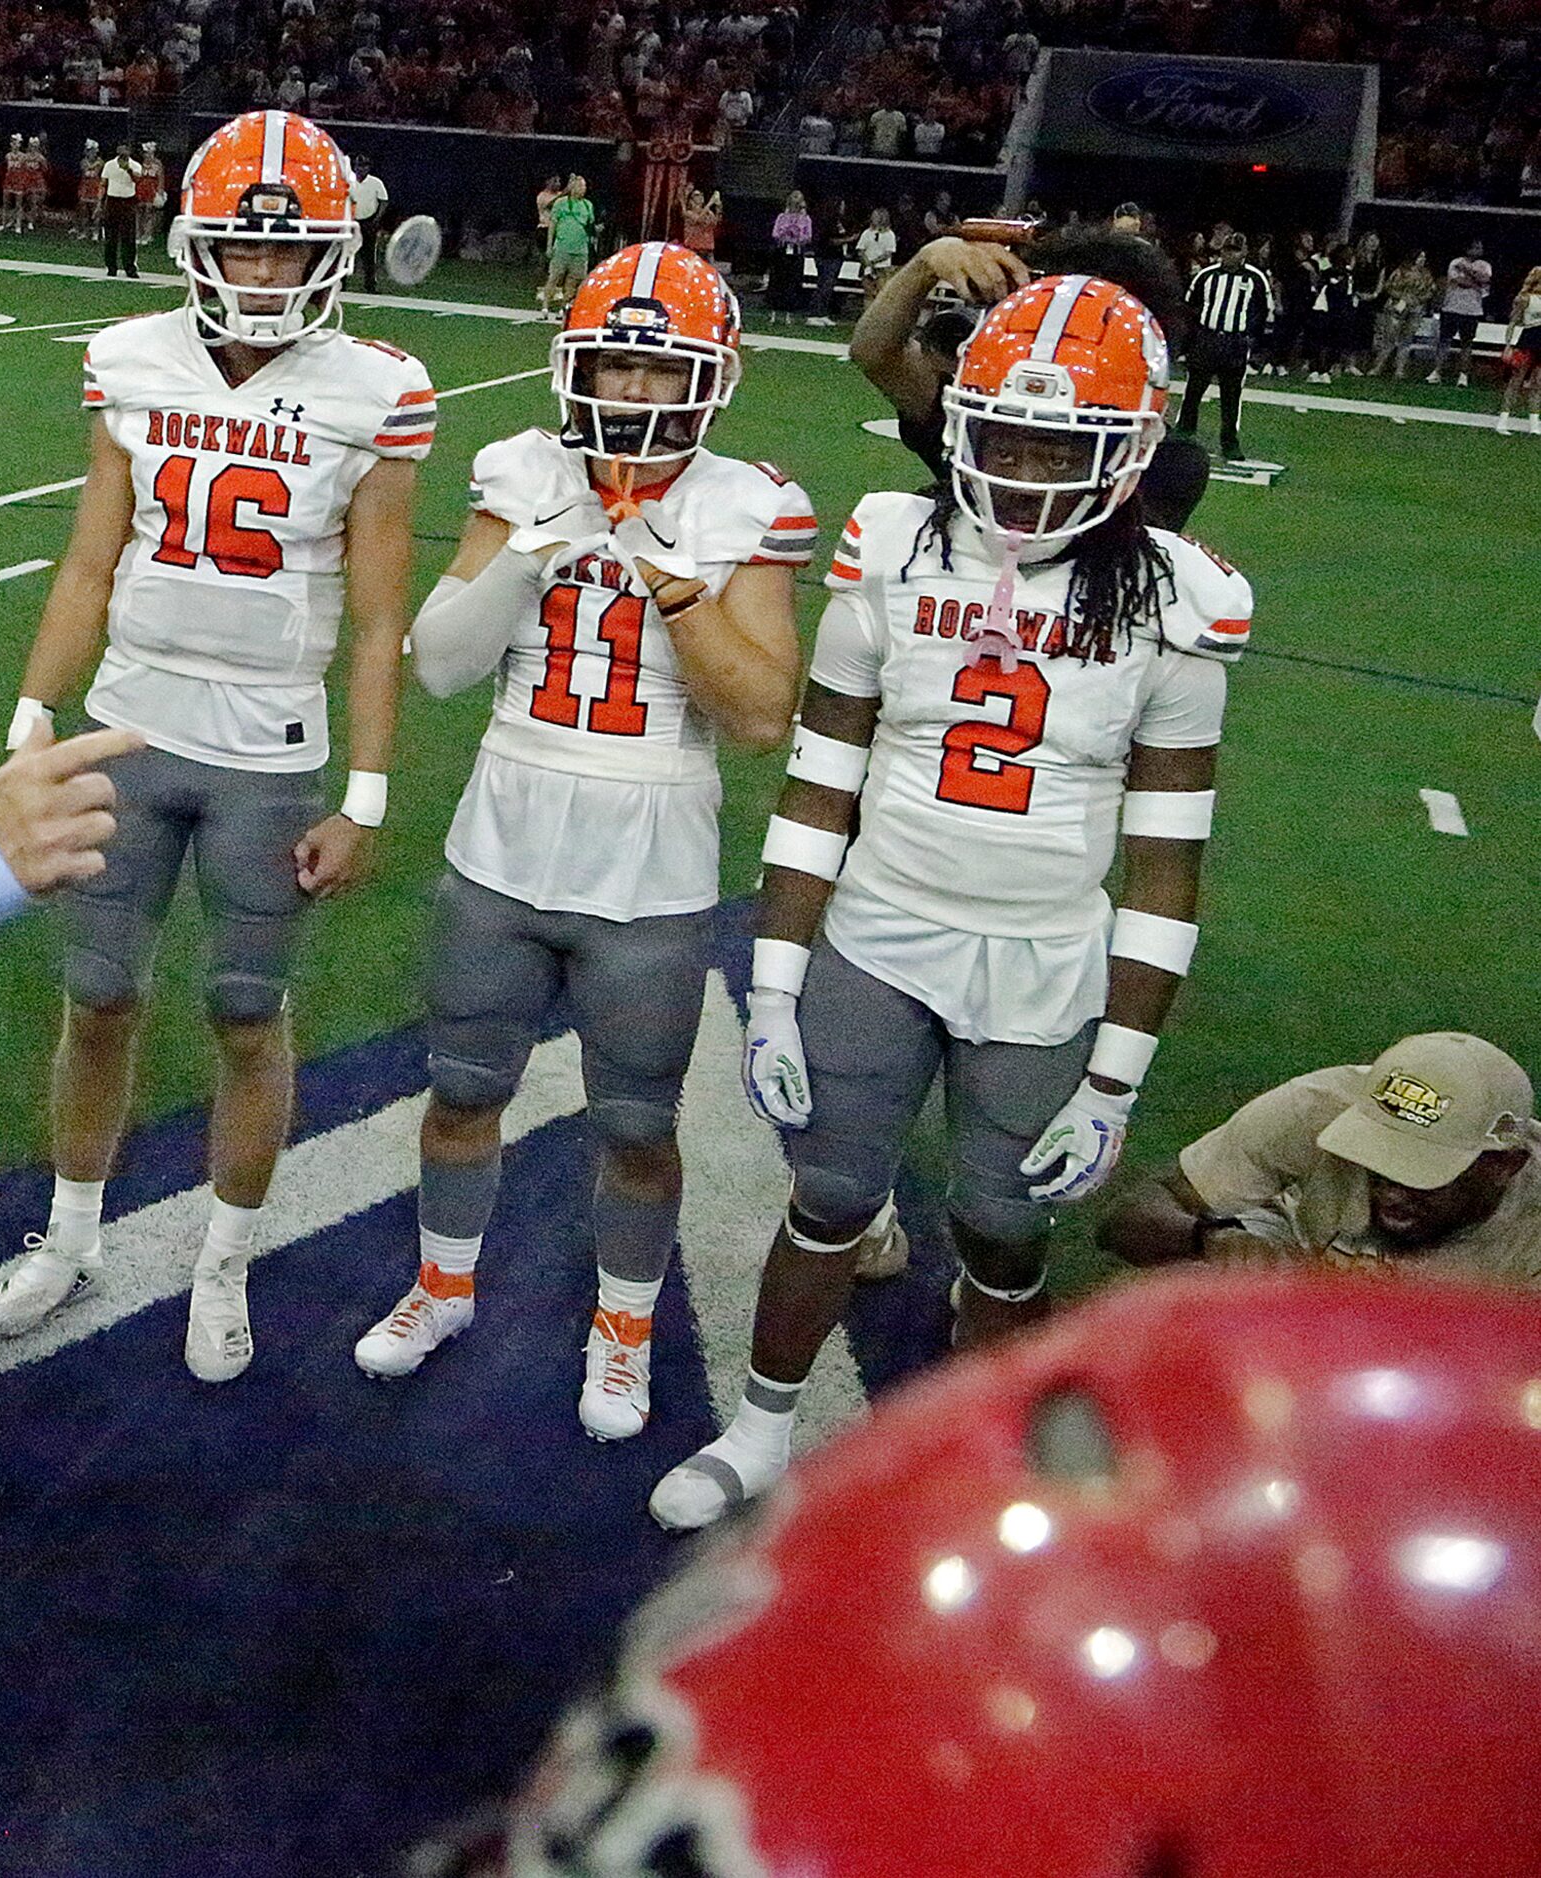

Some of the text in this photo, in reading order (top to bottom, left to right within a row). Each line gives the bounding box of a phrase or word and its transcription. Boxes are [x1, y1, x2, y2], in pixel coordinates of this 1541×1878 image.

[1125, 74, 1269, 132] Ford
[146, 410, 311, 466] ROCKWALL
[151, 454, 291, 579] 16
[529, 583, 649, 737] 11
[935, 654, 1051, 815] 2
[1371, 1090, 1441, 1122] FINALS
[1387, 1078, 1439, 1109] NBA
